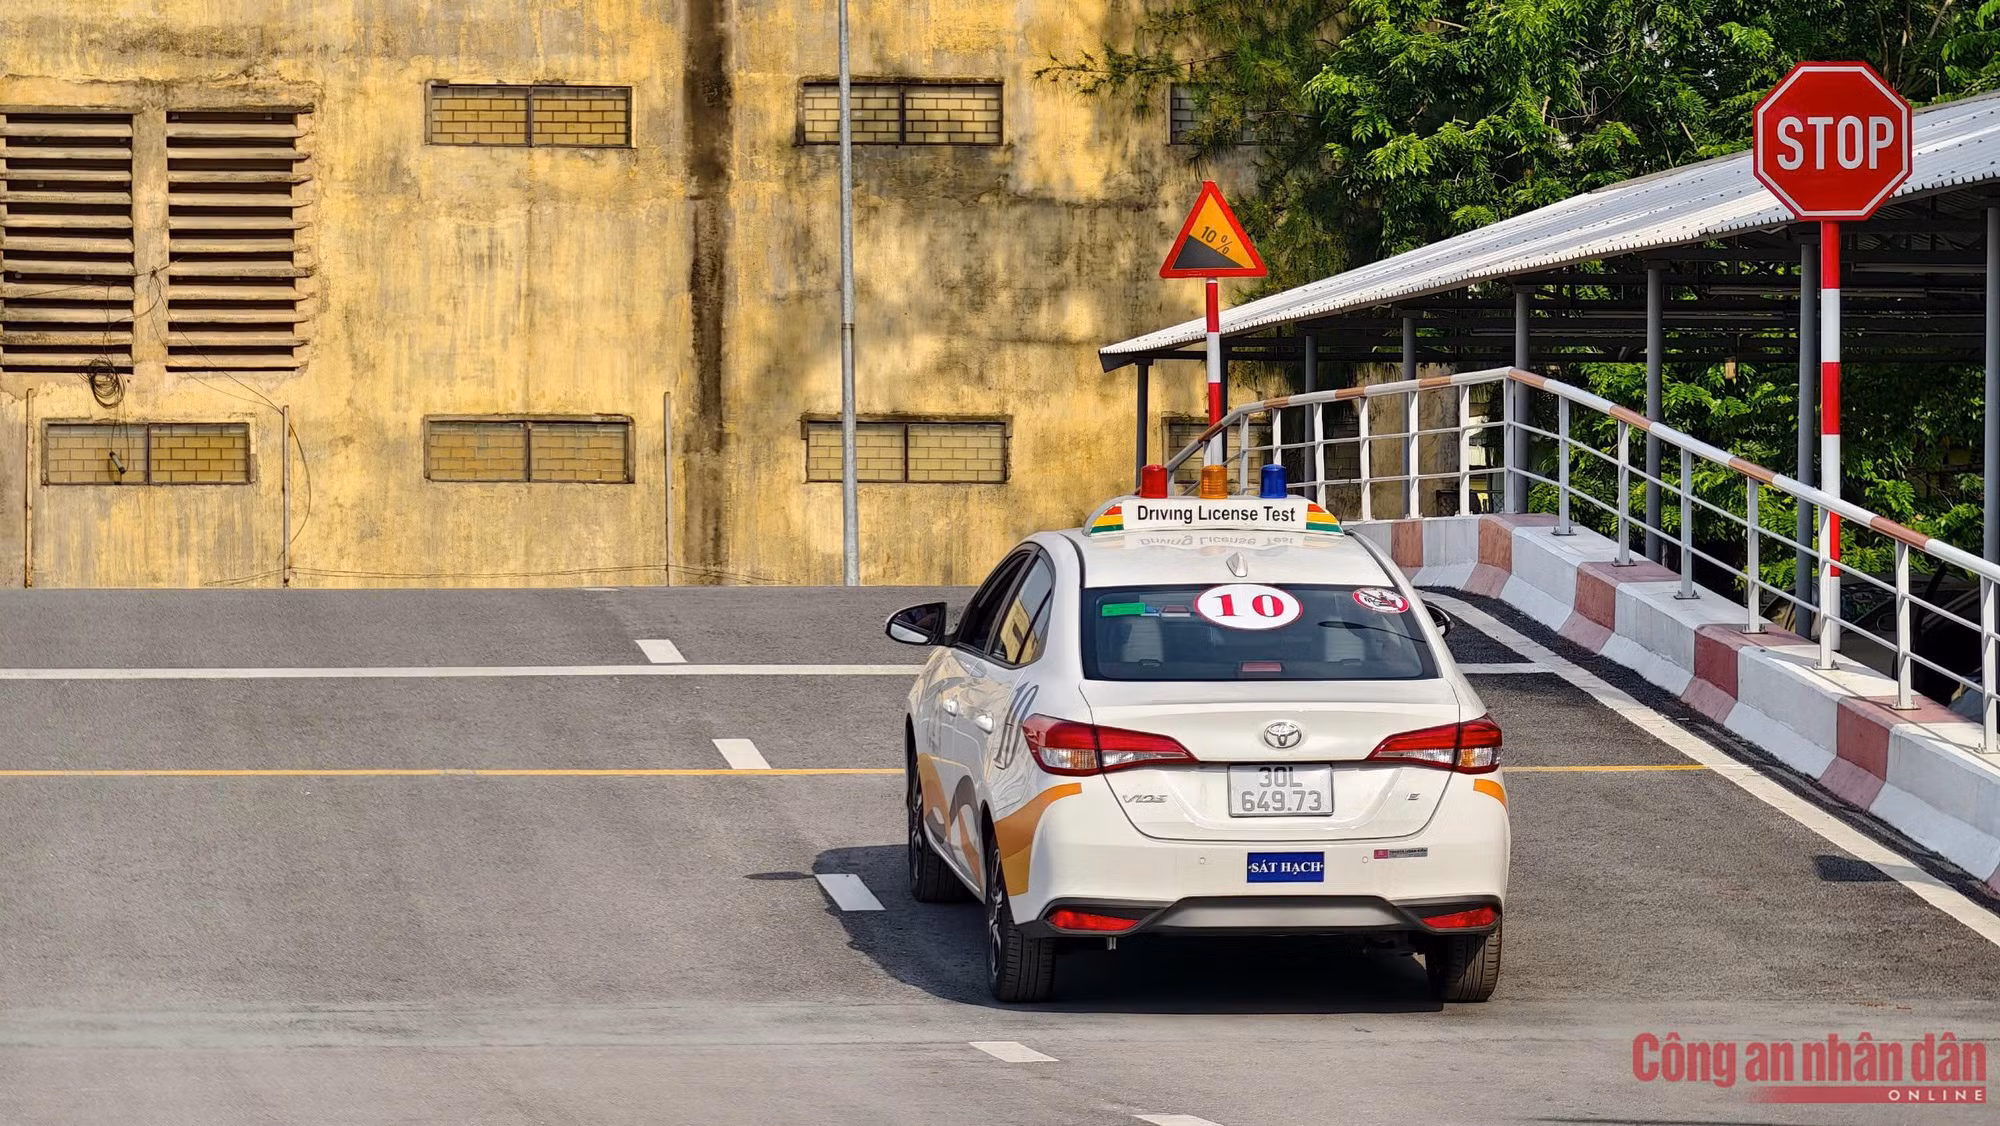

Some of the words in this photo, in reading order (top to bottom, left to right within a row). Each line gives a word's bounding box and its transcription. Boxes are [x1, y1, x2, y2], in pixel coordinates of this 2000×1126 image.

[1777, 116, 1894, 170] STOP
[1137, 505, 1193, 524] Driving
[1198, 505, 1258, 521] License
[1263, 505, 1296, 522] Test
[1212, 593, 1285, 618] 10
[1258, 766, 1303, 788] 30L
[1241, 790, 1322, 812] 649.73
[1251, 859, 1279, 873] SÁT
[1280, 861, 1321, 875] HẠCH
